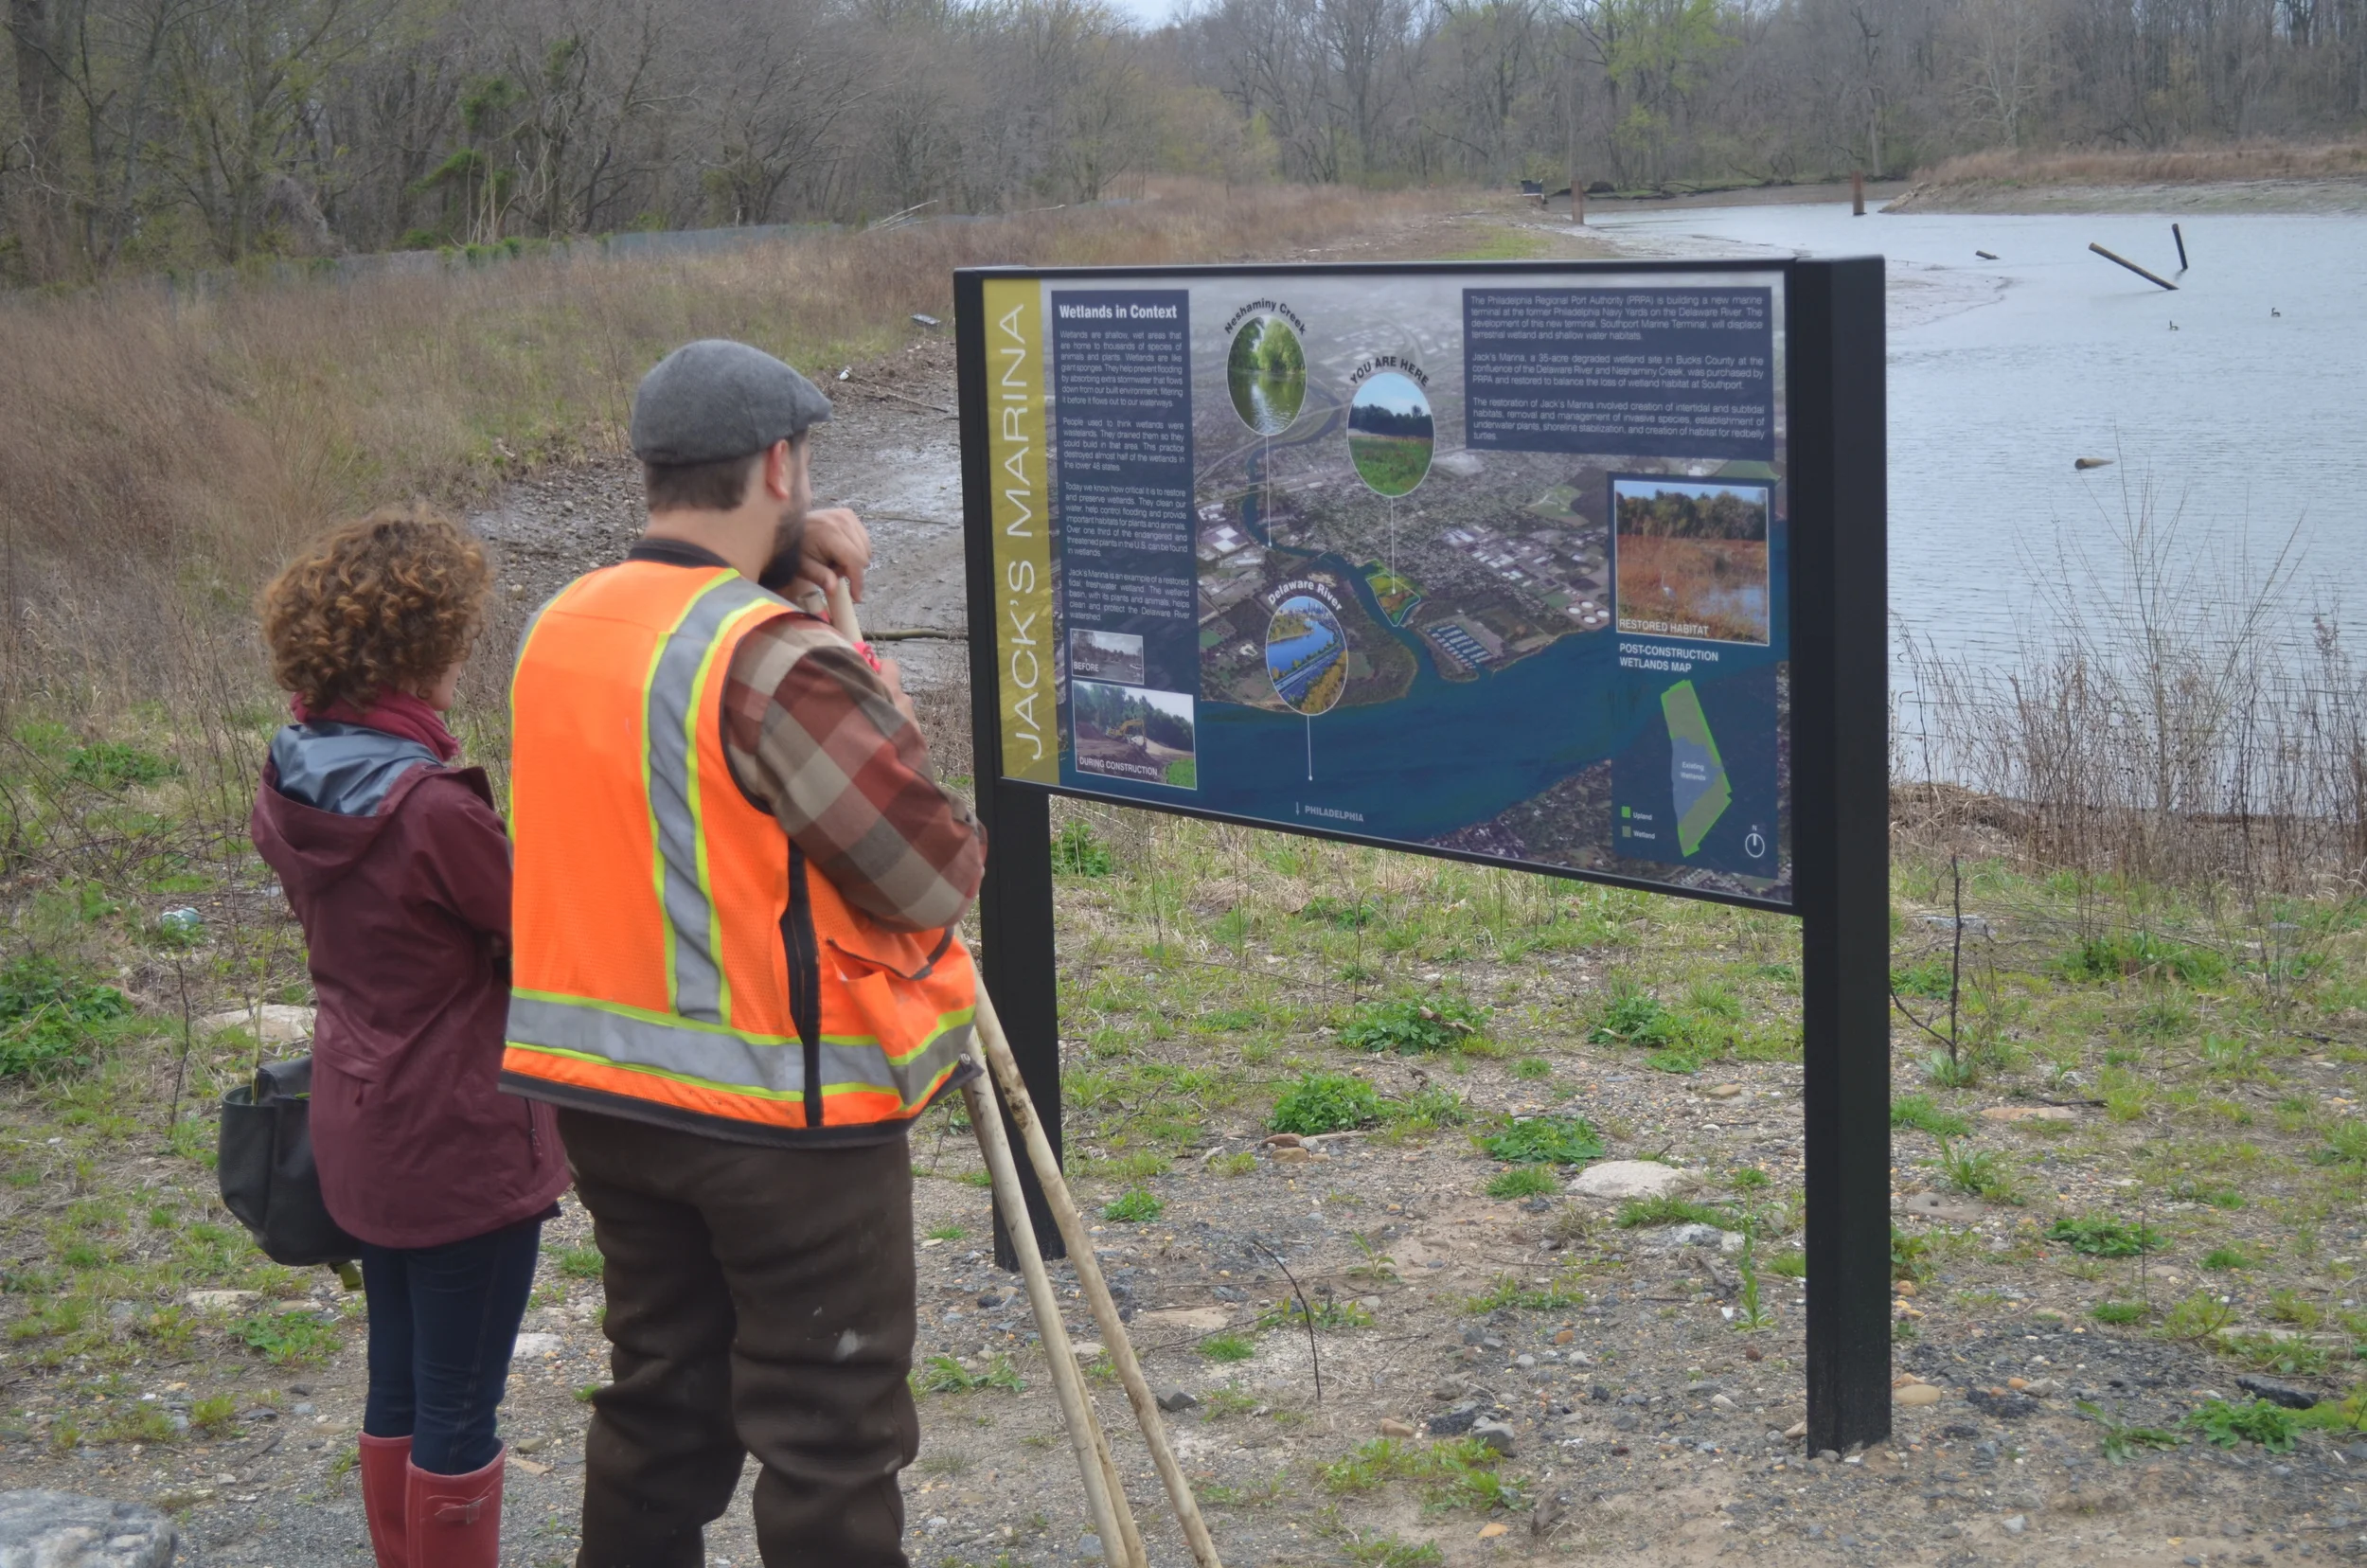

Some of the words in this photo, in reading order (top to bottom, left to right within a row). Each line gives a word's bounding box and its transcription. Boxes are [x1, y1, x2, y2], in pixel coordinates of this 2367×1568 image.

[1487, 296, 1532, 306] Philadelphia
[1535, 296, 1568, 306] Regional
[1589, 296, 1623, 306] Authority
[1626, 295, 1653, 305] (PRPA)
[1665, 295, 1699, 306] building
[1732, 295, 1762, 304] marine
[1059, 305, 1112, 318] Wetlands
[1116, 305, 1127, 318] in
[1130, 305, 1177, 318] Context
[1224, 297, 1276, 335] Neshaminy
[1279, 303, 1307, 335] Creek
[1553, 308, 1600, 317] Philadelphia
[1602, 308, 1622, 317] Navy
[1471, 319, 1519, 329] development
[1600, 319, 1639, 330] Southport
[1727, 320, 1763, 330] displace
[1059, 330, 1088, 338] Wetlands
[1168, 330, 1182, 339] that
[1506, 330, 1537, 339] wetland
[1555, 330, 1583, 339] shallow
[1073, 341, 1091, 349] home
[1103, 341, 1135, 349] thousands
[1147, 341, 1172, 352] species
[1060, 351, 1084, 360] animals
[1125, 352, 1154, 361] Wetlands
[1171, 352, 1182, 361] like
[1572, 354, 1610, 365] degraded
[1675, 355, 1701, 364] Bucks
[1704, 355, 1735, 366] County
[1350, 362, 1372, 384] YOU
[1375, 356, 1397, 367] ARE
[1399, 358, 1430, 387] HERE
[999, 303, 1032, 537] MARINA
[1062, 417, 1083, 427] People
[1087, 418, 1102, 426] used
[1116, 419, 1131, 427] think
[1135, 419, 1164, 428] wetlands
[1506, 411, 1538, 419] removal
[1557, 412, 1610, 423] management
[1623, 413, 1655, 422] invasive
[1695, 415, 1753, 424] establishment
[1063, 438, 1080, 447] could
[1082, 439, 1097, 448] build
[1109, 440, 1121, 449] that
[1143, 441, 1156, 450] This
[1158, 442, 1184, 454] practice
[1078, 495, 1105, 505] preserve
[1139, 496, 1153, 508] They
[1155, 497, 1173, 507] clean
[1085, 504, 1098, 515] help
[1099, 505, 1120, 514] control
[1122, 507, 1147, 518] flooding
[1163, 508, 1186, 521] provide
[1085, 579, 1116, 590] freshwater
[1165, 585, 1189, 596] wetland
[1088, 590, 1100, 599] with
[1110, 592, 1129, 604] plants
[1172, 597, 1189, 609] helps
[1268, 579, 1314, 605] Delaware
[1317, 582, 1343, 612] River
[1069, 599, 1085, 609] clean
[1103, 602, 1125, 615] protect
[1140, 606, 1170, 616] Delaware
[1173, 609, 1190, 618] River
[1619, 619, 1668, 633] RESTORED
[1670, 623, 1709, 634] HABITAT
[1619, 643, 1718, 662] POST-CONSTRUCTION
[1008, 559, 1041, 760] JACK'S
[1620, 657, 1669, 670] WETLANDS
[1671, 662, 1692, 672] MAP
[1074, 662, 1099, 672] BEFORE
[1079, 757, 1104, 768] DURING
[1106, 761, 1158, 775] CONSTRUCTION
[1682, 761, 1704, 772] Existing
[1680, 771, 1706, 781] Wetlands
[1305, 805, 1364, 822] PHILADELPHIA
[1633, 811, 1652, 821] Upland
[1633, 830, 1656, 840] Wetland
